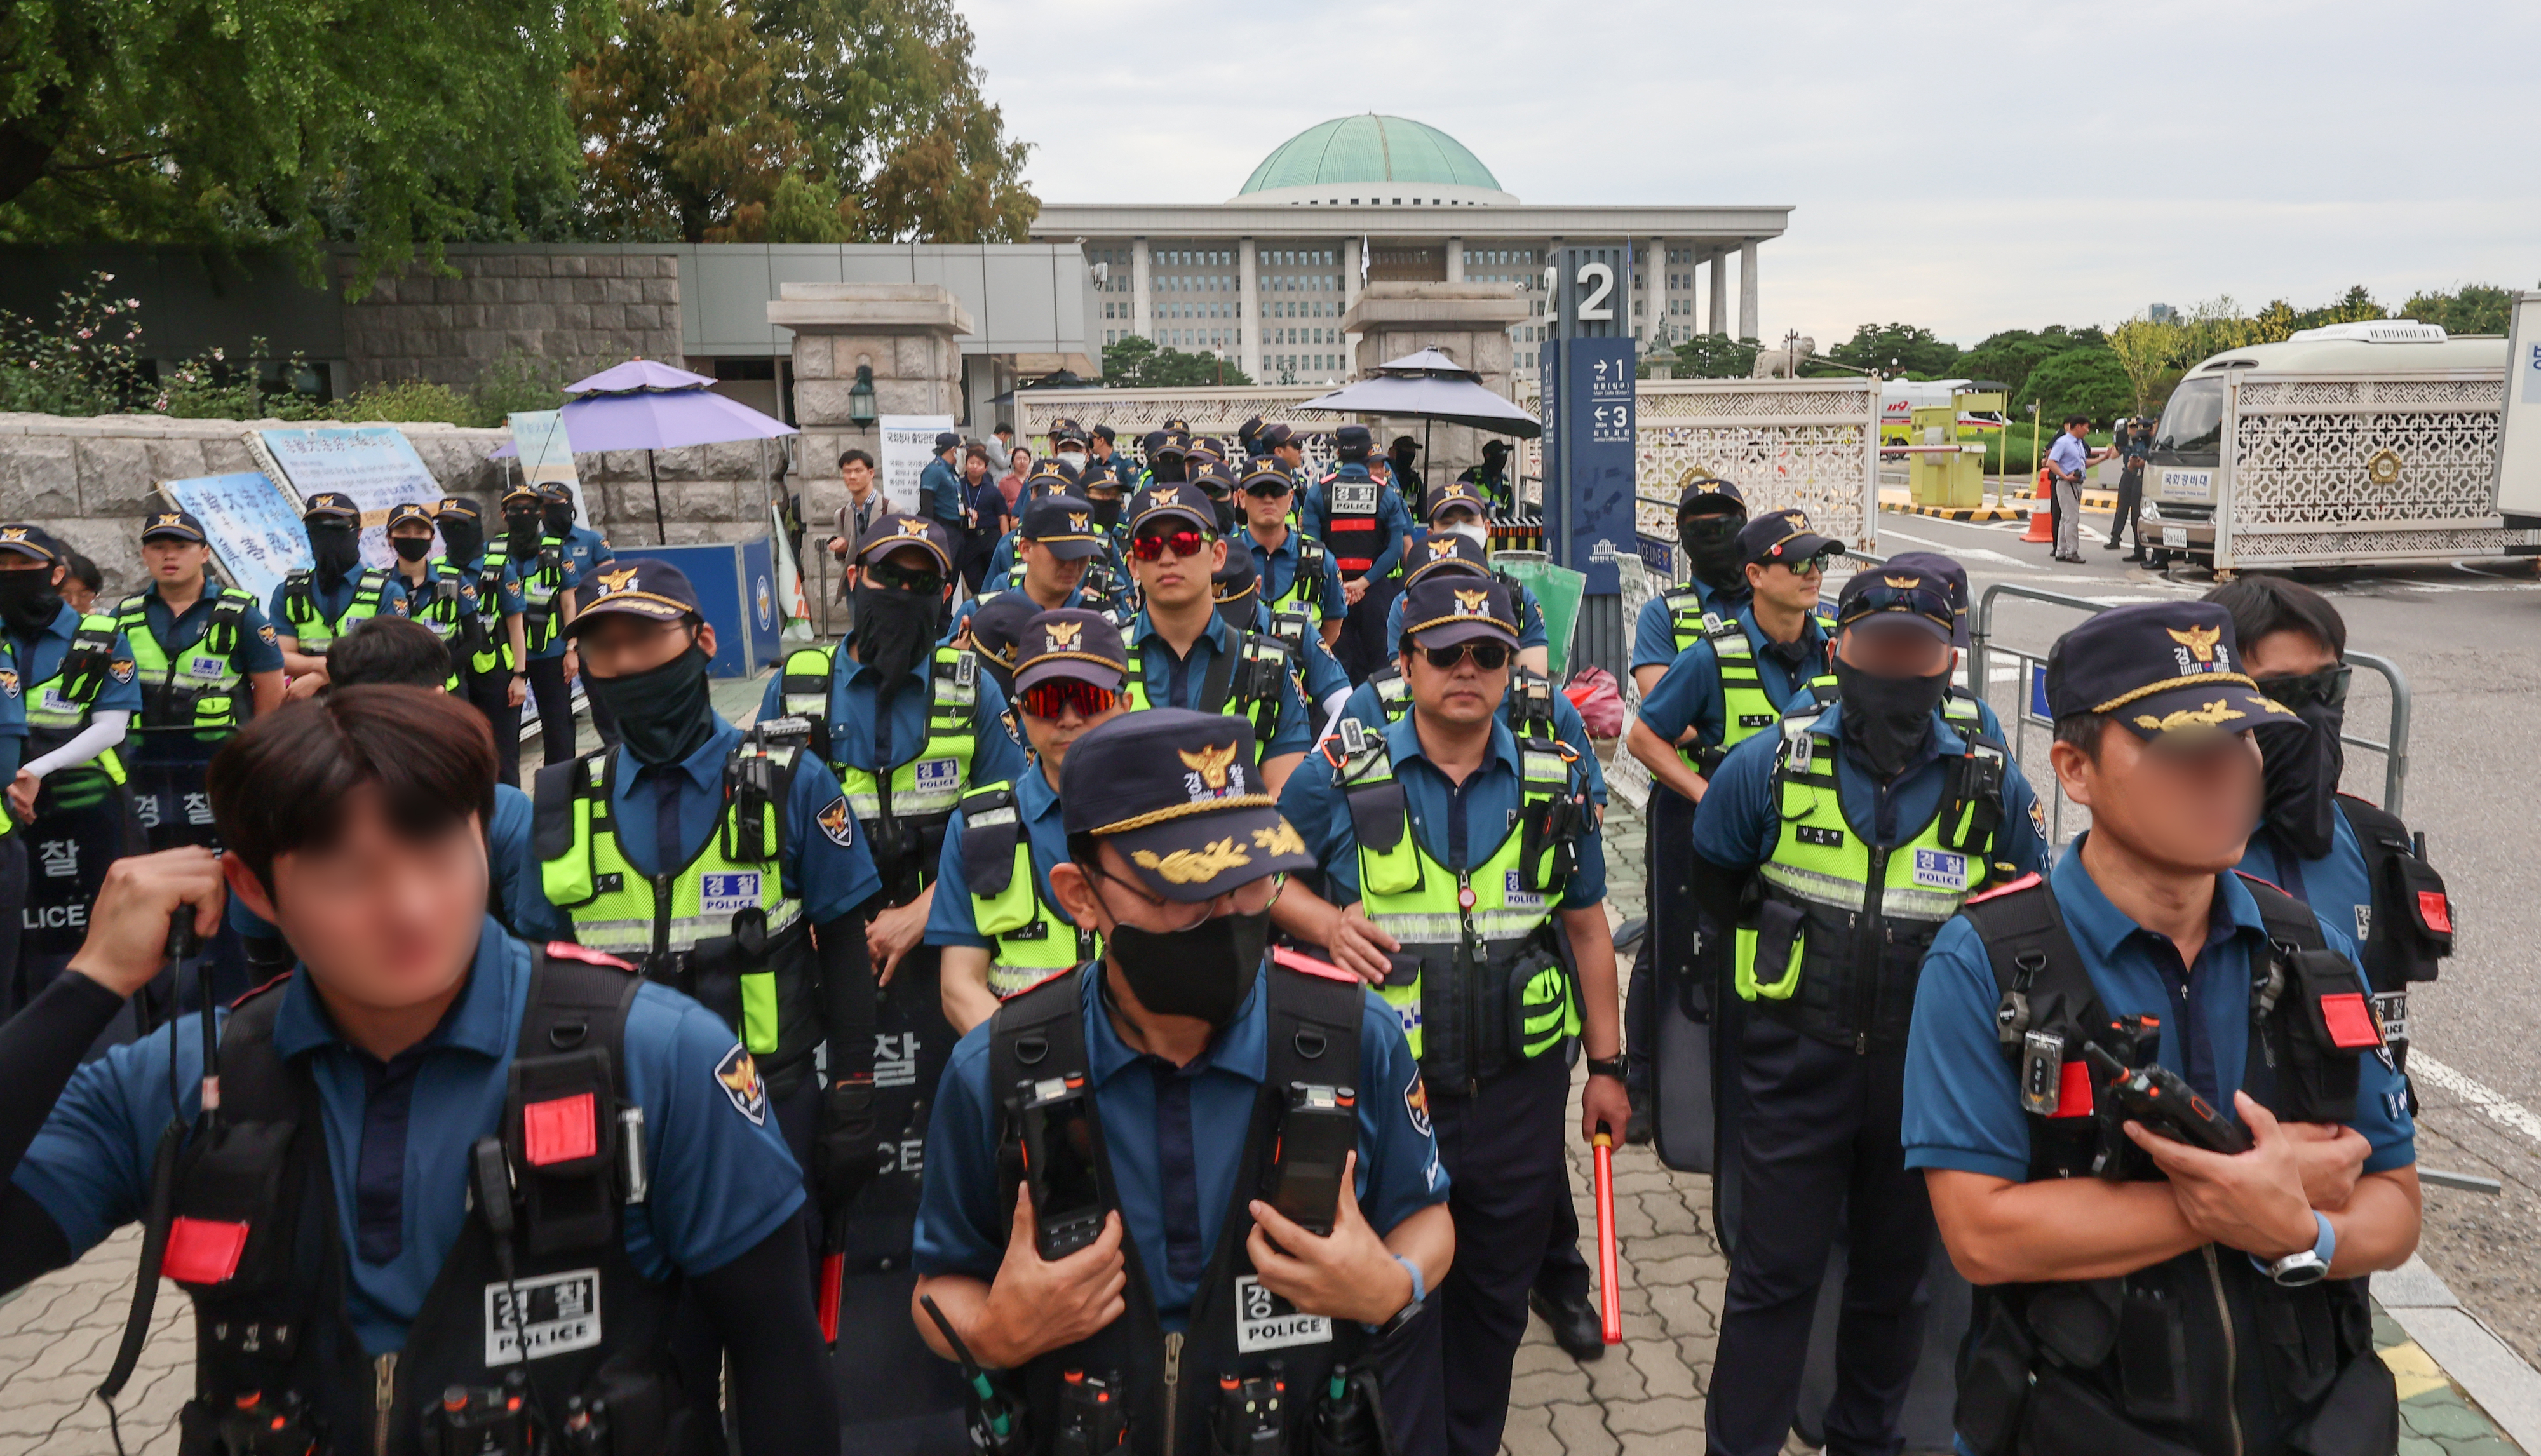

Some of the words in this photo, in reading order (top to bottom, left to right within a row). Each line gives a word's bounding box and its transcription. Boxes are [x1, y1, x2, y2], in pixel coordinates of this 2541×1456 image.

[1577, 262, 1614, 320] 2
[1615, 358, 1623, 381] 1
[1887, 400, 1908, 412] 119
[1613, 405, 1628, 428] 3
[2165, 473, 2208, 487] 국회경비대
[1337, 487, 1372, 501] 경찰
[1650, 546, 1661, 566] LINE
[918, 761, 955, 778] 경찰
[920, 778, 955, 789] POLICE
[1919, 851, 1962, 875] 경찰
[706, 877, 754, 896] 경찰
[1507, 873, 1520, 892] 경
[1918, 872, 1961, 886] POLICE
[705, 899, 755, 911] POLICE
[1508, 894, 1540, 903] POLICE
[1246, 1286, 1271, 1319] 경
[499, 1323, 588, 1353] POLICE
[1248, 1320, 1322, 1340] POLICE
